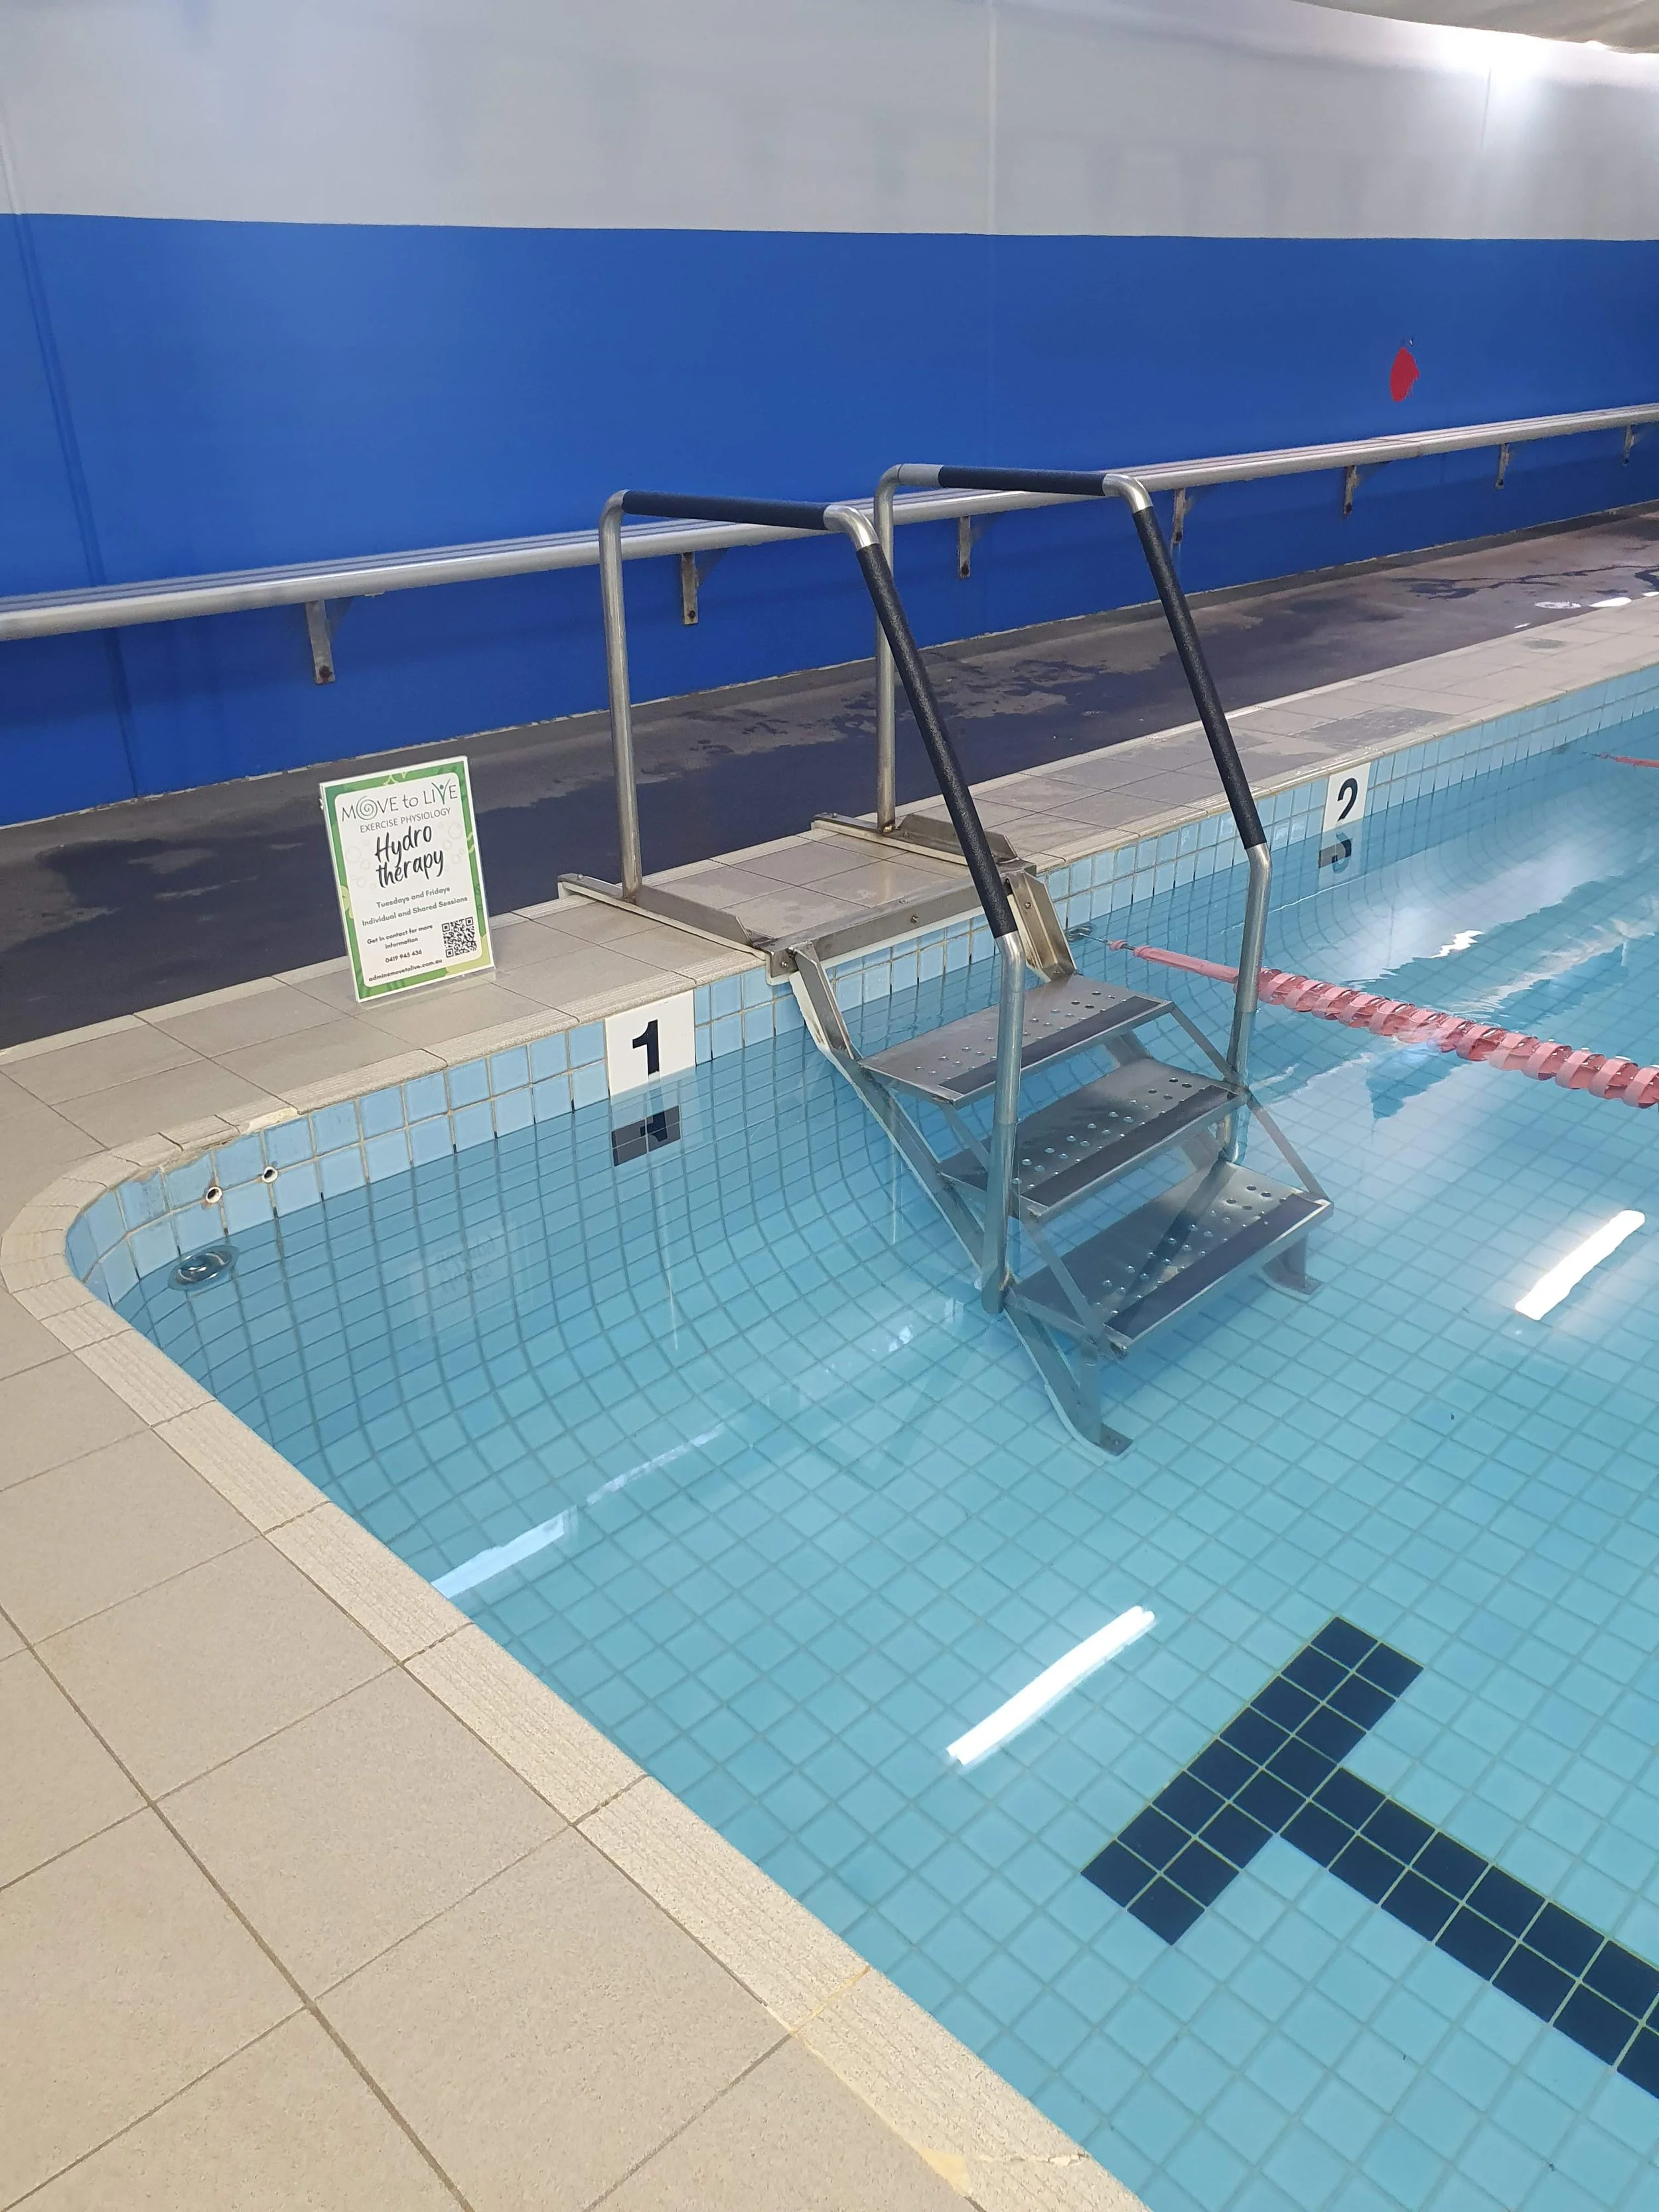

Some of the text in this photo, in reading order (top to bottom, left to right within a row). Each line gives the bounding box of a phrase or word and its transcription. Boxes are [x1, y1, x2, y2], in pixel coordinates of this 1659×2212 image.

[402, 794, 419, 808] to
[423, 779, 458, 805] LIVE
[360, 807, 451, 833] EXERCISE PHYSIOLOGY
[374, 825, 432, 869] Hydro
[376, 849, 444, 888] therapy
[362, 896, 468, 926] Individual and Shared Sessions
[376, 887, 451, 909] Tuesdays and Fridays
[385, 937, 419, 950] information
[386, 930, 408, 940] contact
[632, 1019, 660, 1076] 1
